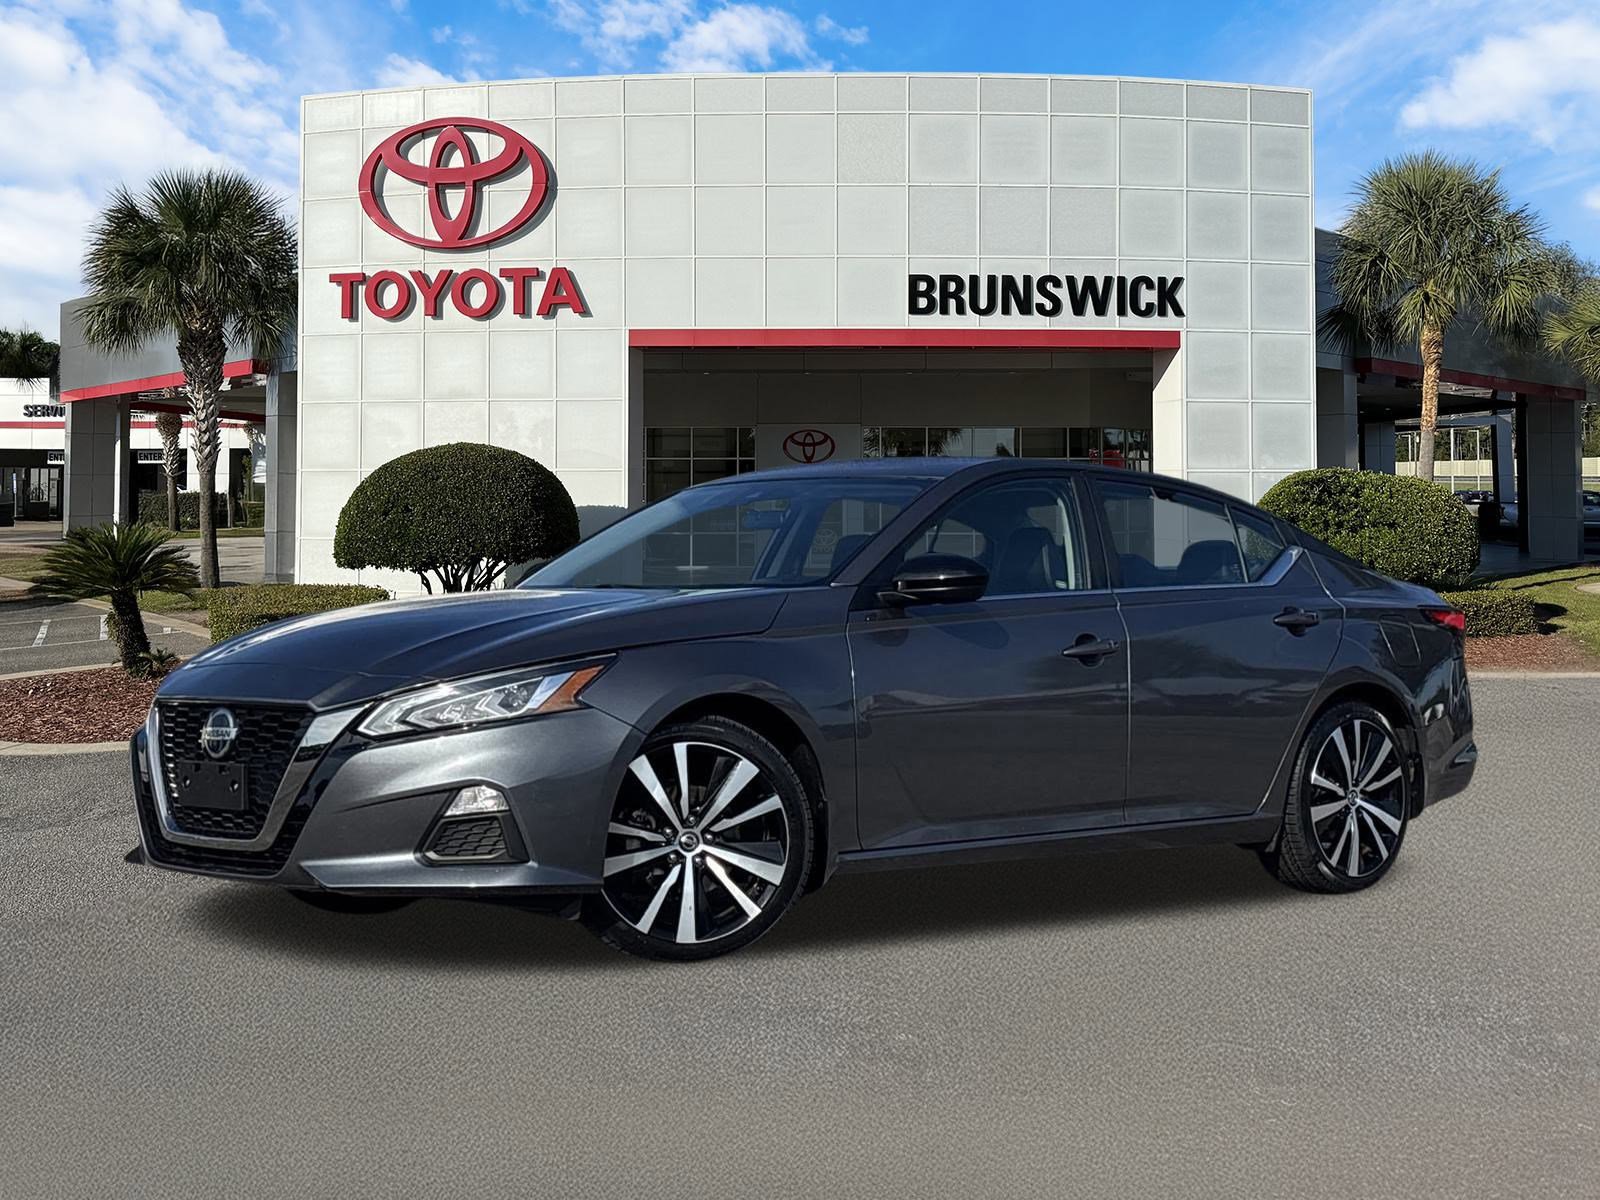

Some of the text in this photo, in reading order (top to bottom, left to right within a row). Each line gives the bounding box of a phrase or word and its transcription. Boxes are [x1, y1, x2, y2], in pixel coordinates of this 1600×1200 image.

[329, 267, 585, 319] TOYOTA
[908, 274, 1185, 317] BRUNSWICK
[139, 453, 163, 461] ENTER
